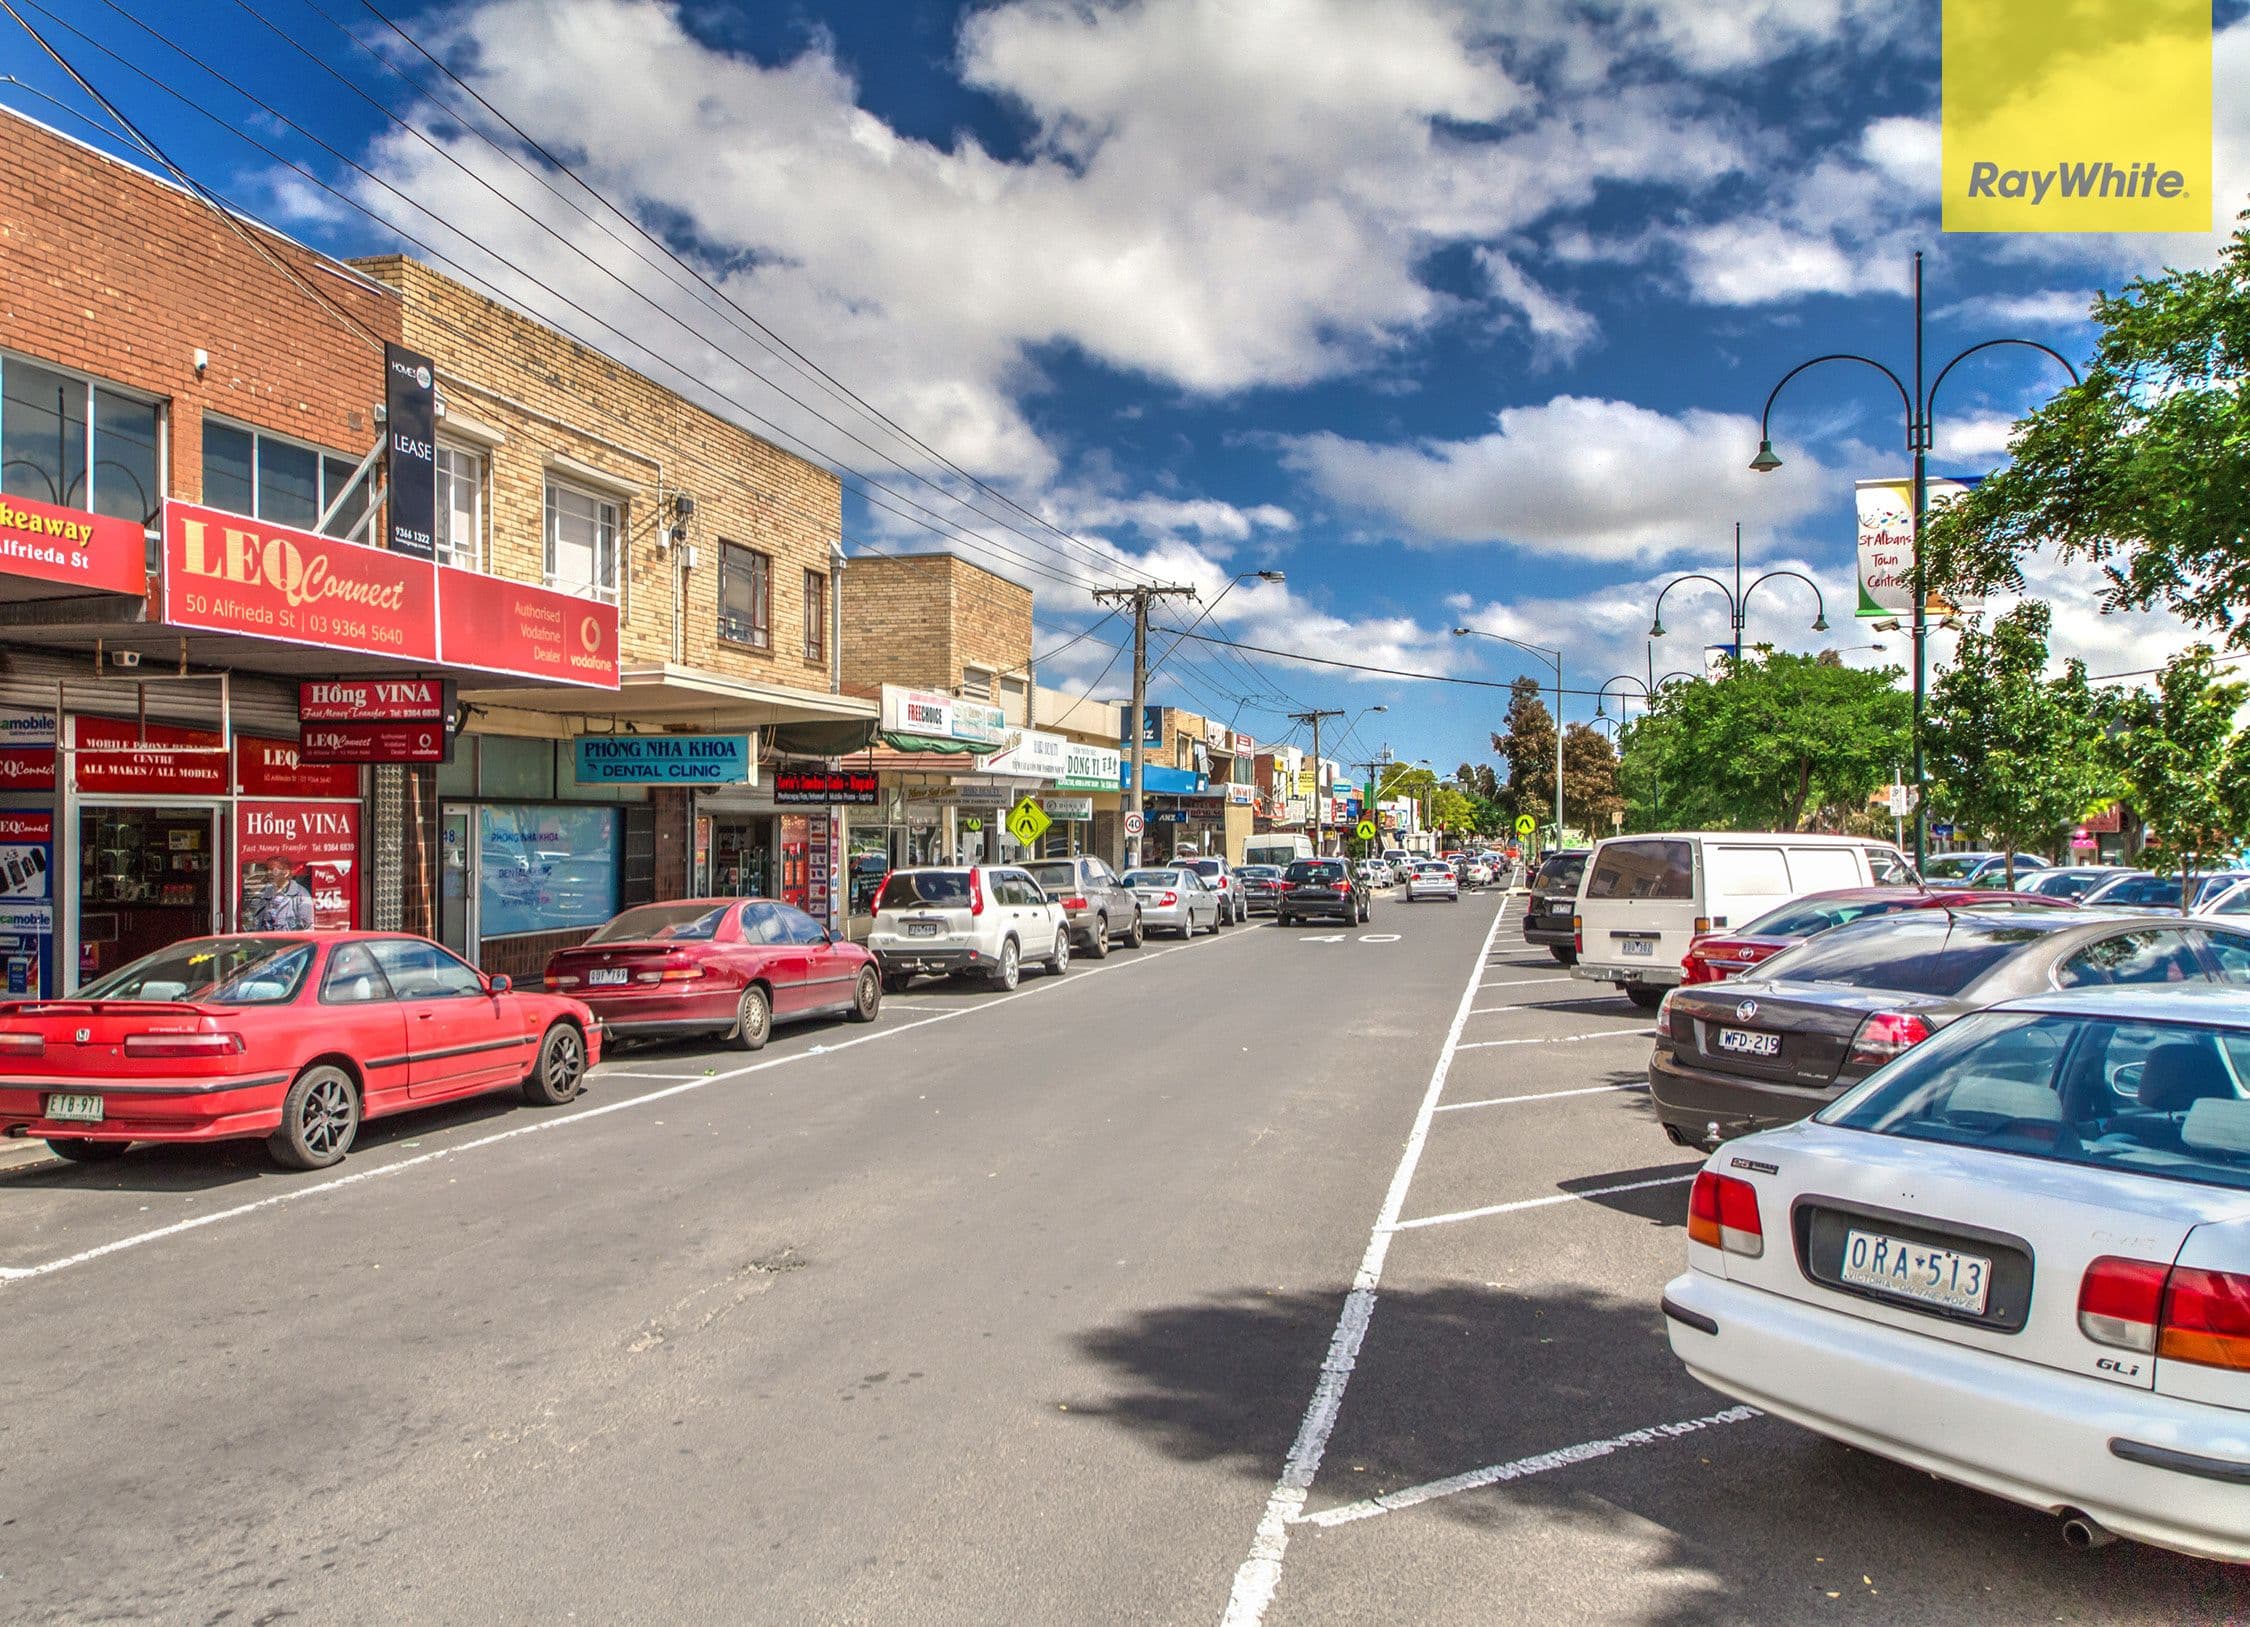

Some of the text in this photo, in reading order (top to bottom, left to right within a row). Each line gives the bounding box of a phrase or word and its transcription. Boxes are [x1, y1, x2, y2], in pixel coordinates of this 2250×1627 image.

[394, 433, 432, 462] LEASE
[395, 526, 430, 545] 9366 1322
[1874, 530, 1912, 546] Albans
[0, 539, 89, 569] lfrieda St
[1871, 553, 1898, 567] Town
[1867, 574, 1902, 588] Centre
[185, 594, 403, 645] 50 Alfrieda St 03 9364 5640
[514, 601, 560, 623] Authorised
[520, 624, 560, 643] Vodafone
[534, 646, 560, 663] Dealer
[570, 654, 612, 672] vodafone
[311, 683, 431, 708] Hồng VINA
[301, 707, 323, 719] Fast
[324, 708, 348, 720] Money
[348, 707, 386, 718] Transfer
[86, 738, 129, 749] MOBILE
[584, 738, 737, 757] PHÒNG NHA KHOA
[133, 754, 174, 765] CENTRE
[1067, 755, 1099, 776] DONG YI
[84, 764, 105, 774] ALL
[108, 765, 147, 776] MAKES
[156, 767, 176, 777] ALL
[179, 768, 219, 779] MODELS
[602, 764, 721, 777] DENTAL CLINIC
[18, 821, 49, 833] Connect
[247, 811, 351, 840] Hồng VINA
[1128, 819, 1141, 829] 40
[241, 844, 257, 854] Fast
[259, 844, 280, 853] Money
[281, 843, 308, 852] Transfer
[324, 843, 338, 852] 9364
[315, 890, 342, 910] 365
[1299, 934, 1402, 943] 40
[1849, 1271, 1974, 1308] VICTORIA ON THE MOVE
[2096, 1358, 2140, 1376] GLi
